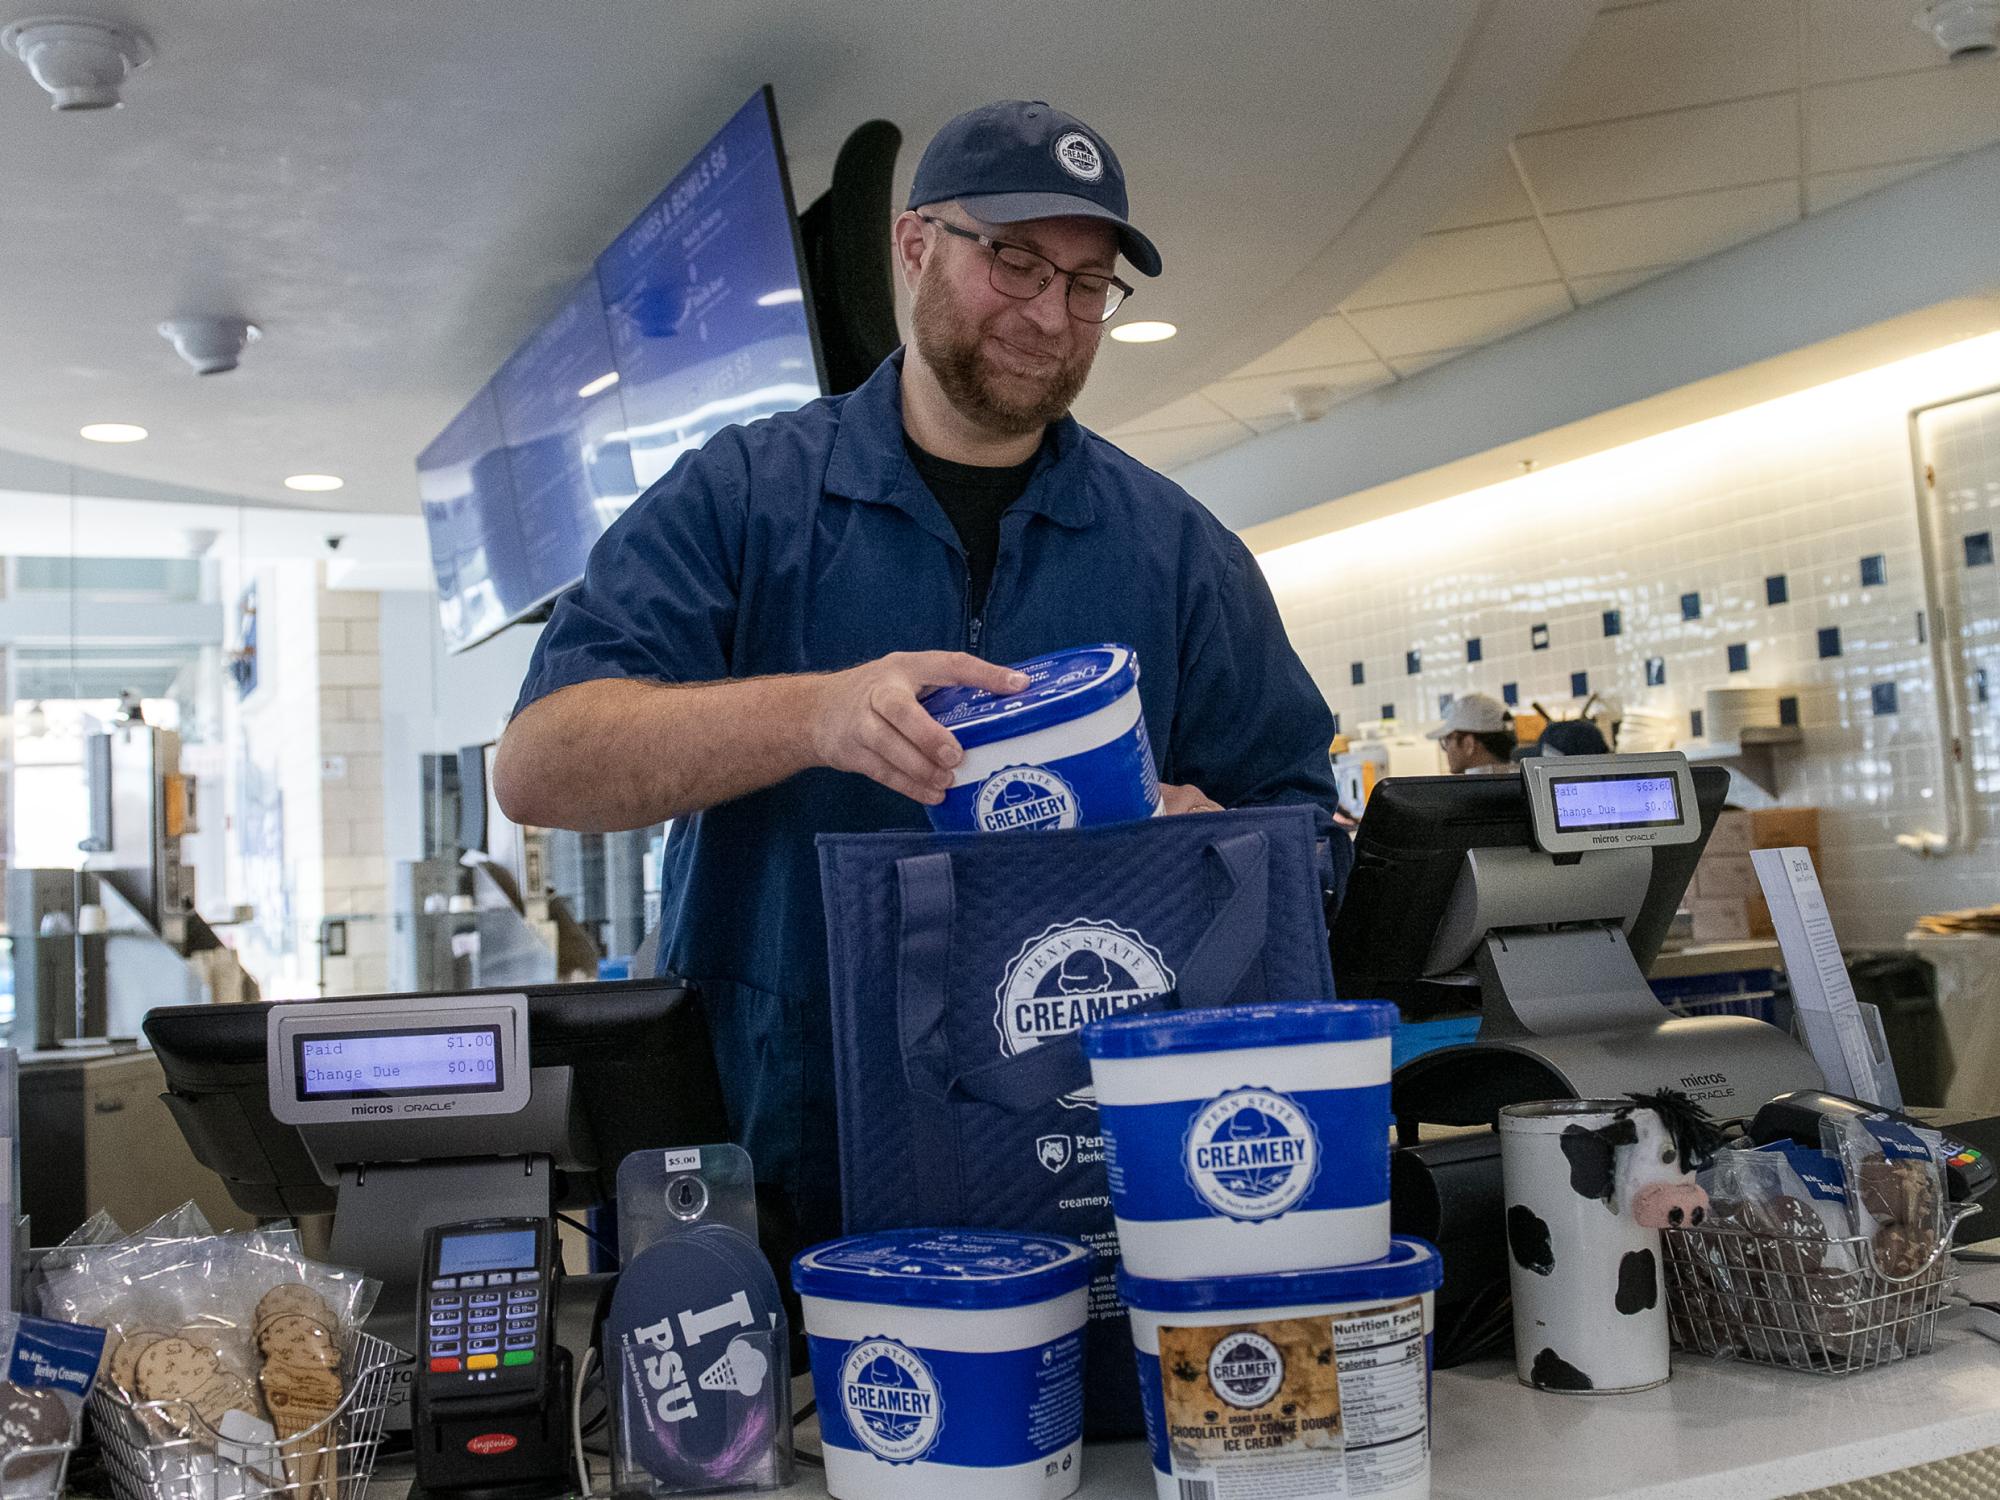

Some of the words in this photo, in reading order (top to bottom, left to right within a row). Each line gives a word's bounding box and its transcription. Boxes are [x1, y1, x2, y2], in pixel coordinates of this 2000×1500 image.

[1062, 148, 1099, 167] CREAMERY
[983, 775, 1008, 803] PENN
[1012, 772, 1052, 786] STATE
[985, 794, 1069, 832] CREAMERY
[1599, 804, 1616, 815] Due
[1645, 801, 1674, 812] $0.00
[1592, 834, 1620, 845] micros
[1023, 939, 1073, 981] PENN
[1082, 936, 1145, 972] STATE
[1015, 992, 1160, 1034] CREAME
[305, 1043, 343, 1056] Paid
[447, 1034, 493, 1048] $1.00
[306, 1069, 363, 1084] Change
[373, 1066, 400, 1078] Due
[448, 1060, 494, 1074] $0.00
[1680, 1073, 1727, 1088] micros
[1689, 1088, 1735, 1101] ORACLE
[351, 1103, 394, 1116] micros
[403, 1101, 456, 1113] ORACLE
[1203, 1099, 1239, 1130] PENN
[1247, 1097, 1295, 1121] STATE
[1075, 1135, 1104, 1149] Pen
[668, 1156, 696, 1166] $5.00
[1077, 1150, 1107, 1164] Berke
[1197, 1139, 1305, 1169] CREAMERY
[1058, 1196, 1112, 1209] creamery.
[1080, 1233, 1094, 1243] Dry
[1095, 1232, 1107, 1241] Ice
[1334, 1319, 1390, 1336] Nutrition
[1391, 1309, 1420, 1326] Facts
[634, 1317, 698, 1422] PSU
[851, 1345, 878, 1370] PENN
[883, 1346, 921, 1377] STATE
[1213, 1361, 1277, 1379] CREAMERY
[1337, 1358, 1377, 1370] Calories
[34, 1363, 57, 1382] Berkey
[58, 1366, 89, 1388] Creamery
[848, 1384, 931, 1414] CREAMERY
[641, 1398, 655, 1432] Creamery
[1170, 1425, 1228, 1440] CHOCOLATE
[1231, 1424, 1256, 1437] CHIP
[1259, 1419, 1298, 1434] COOKIE
[1301, 1415, 1338, 1431] DOUGH
[472, 1437, 514, 1454] ingenico
[1223, 1440, 1241, 1451] ICE
[1244, 1436, 1283, 1450] CREAM
